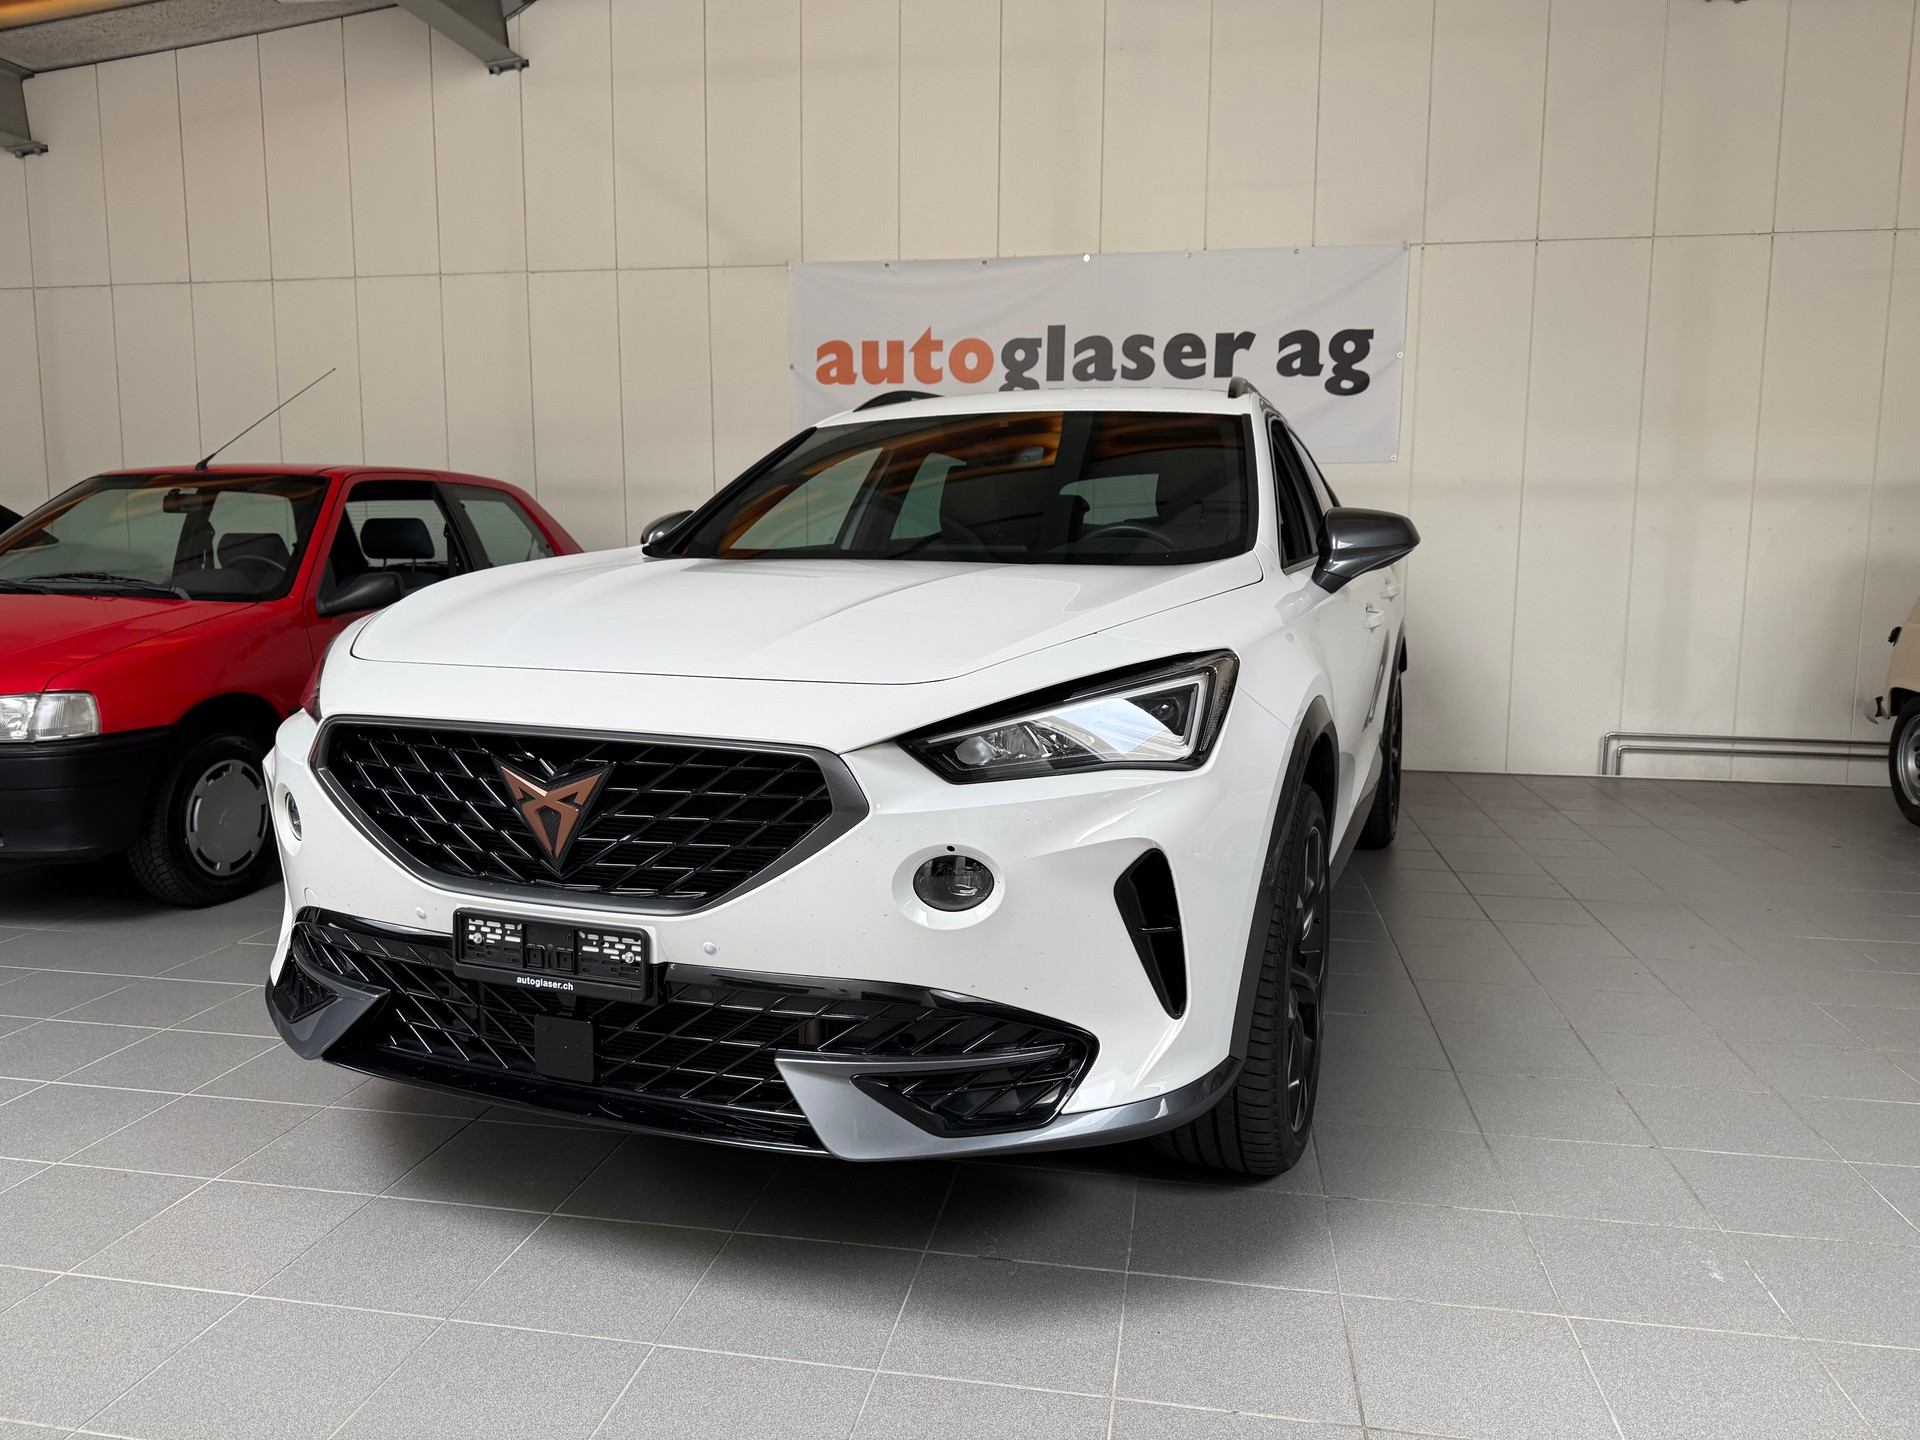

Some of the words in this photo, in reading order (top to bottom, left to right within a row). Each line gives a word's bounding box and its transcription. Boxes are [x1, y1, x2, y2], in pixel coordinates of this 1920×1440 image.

[815, 324, 1256, 390] autoglaser
[1275, 328, 1375, 396] ag
[516, 976, 574, 991] autoglaser.ch
